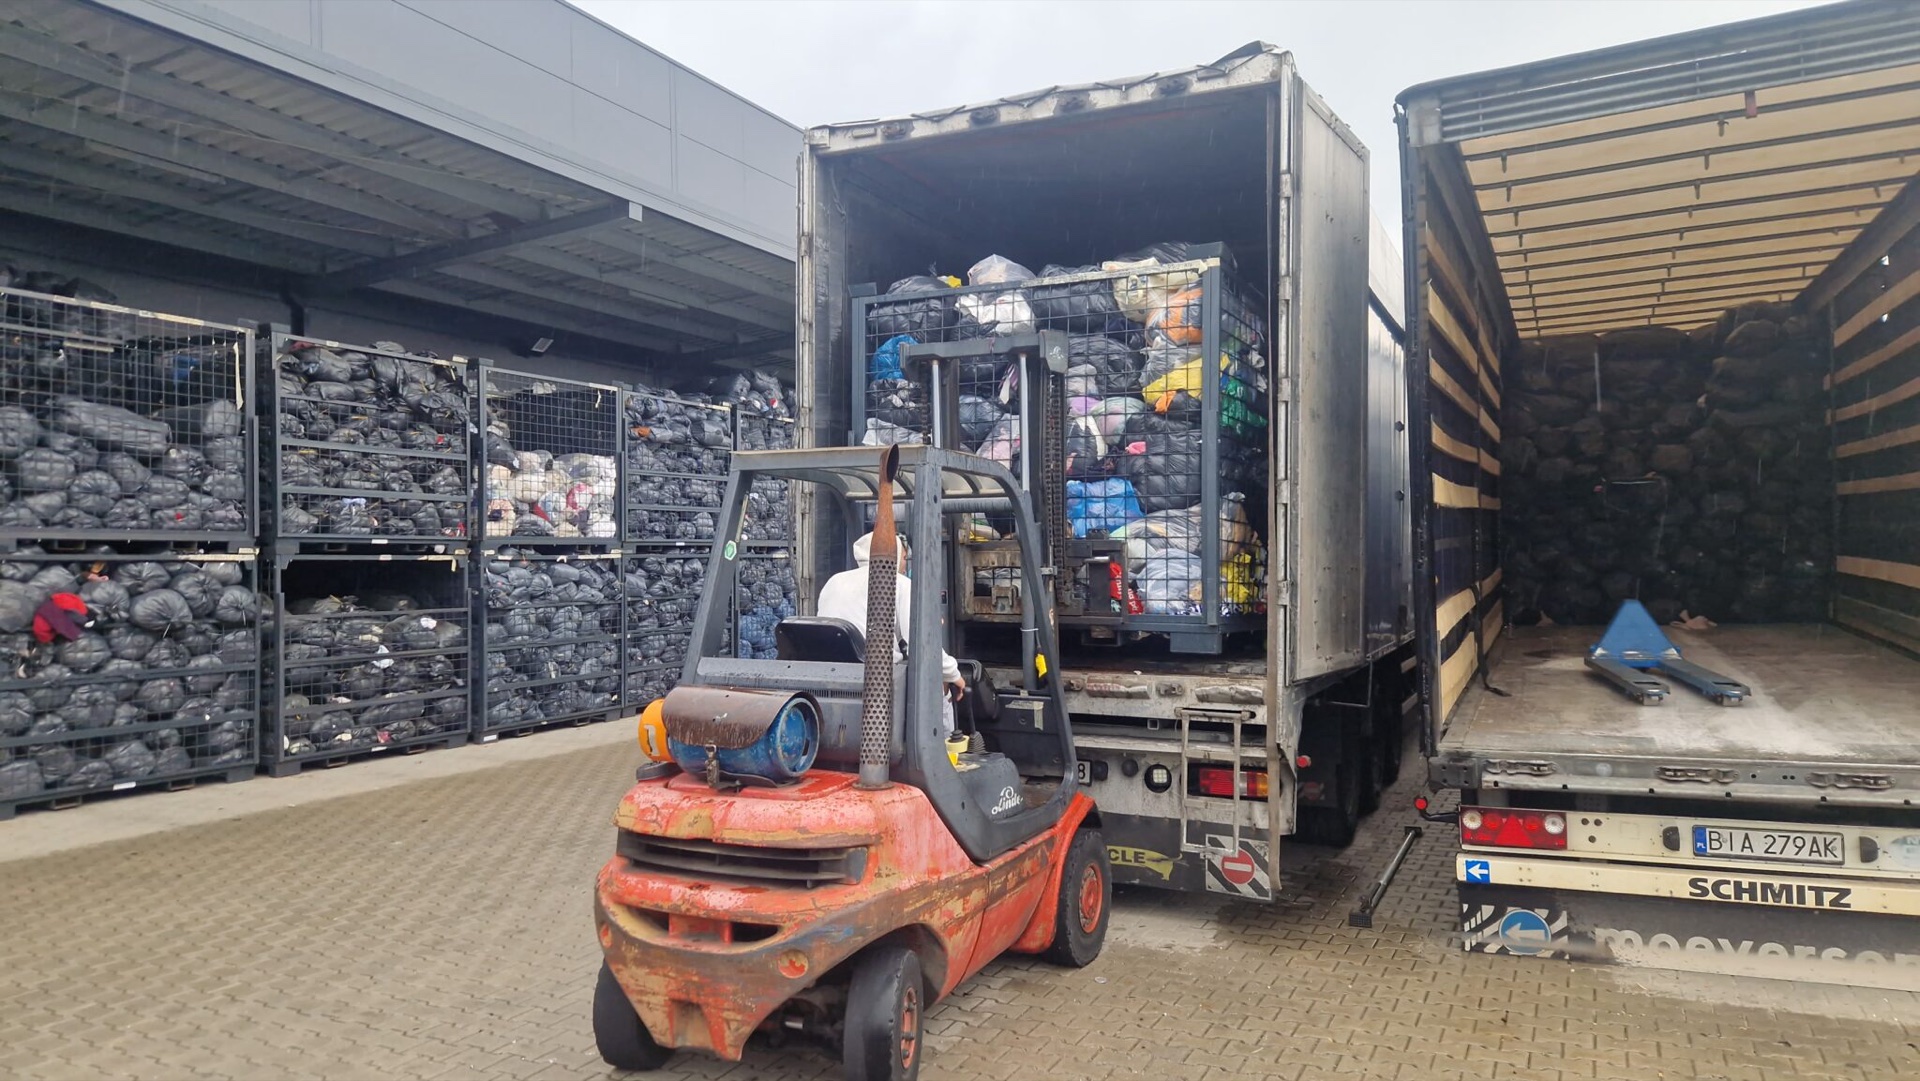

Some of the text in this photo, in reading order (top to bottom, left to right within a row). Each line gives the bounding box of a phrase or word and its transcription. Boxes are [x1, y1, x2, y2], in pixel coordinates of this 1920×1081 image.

[991, 785, 1024, 815] Linde
[1108, 848, 1146, 865] CLE
[1709, 830, 1838, 859] BIA 279AK
[1688, 877, 1852, 909] SCHMITZ
